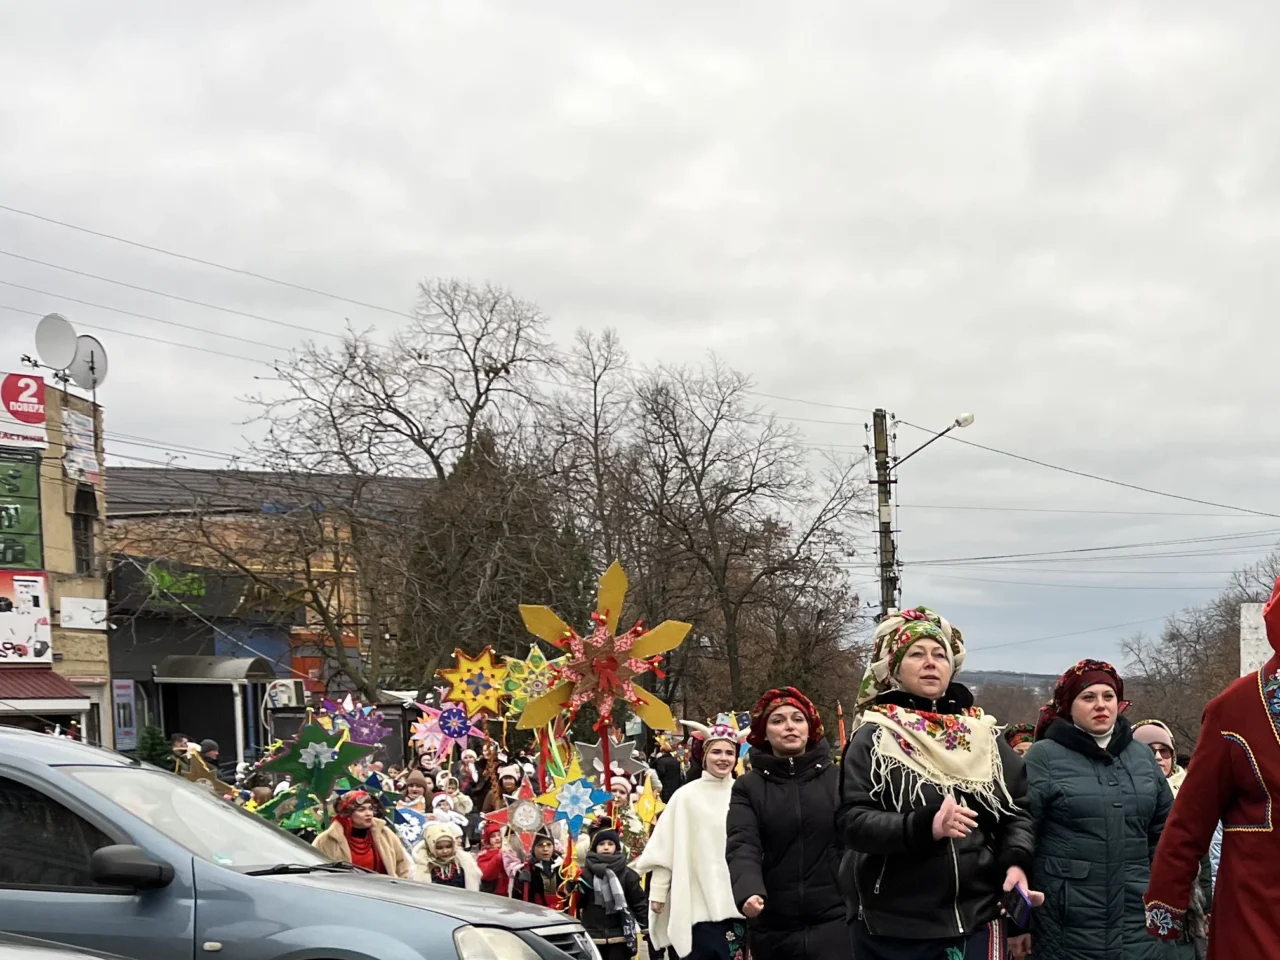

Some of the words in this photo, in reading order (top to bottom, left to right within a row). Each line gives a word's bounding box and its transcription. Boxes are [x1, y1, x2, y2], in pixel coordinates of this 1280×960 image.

[17, 377, 38, 403] 2
[9, 401, 45, 414] ПОВЕРХ
[0, 431, 44, 442] АСТИНИ
